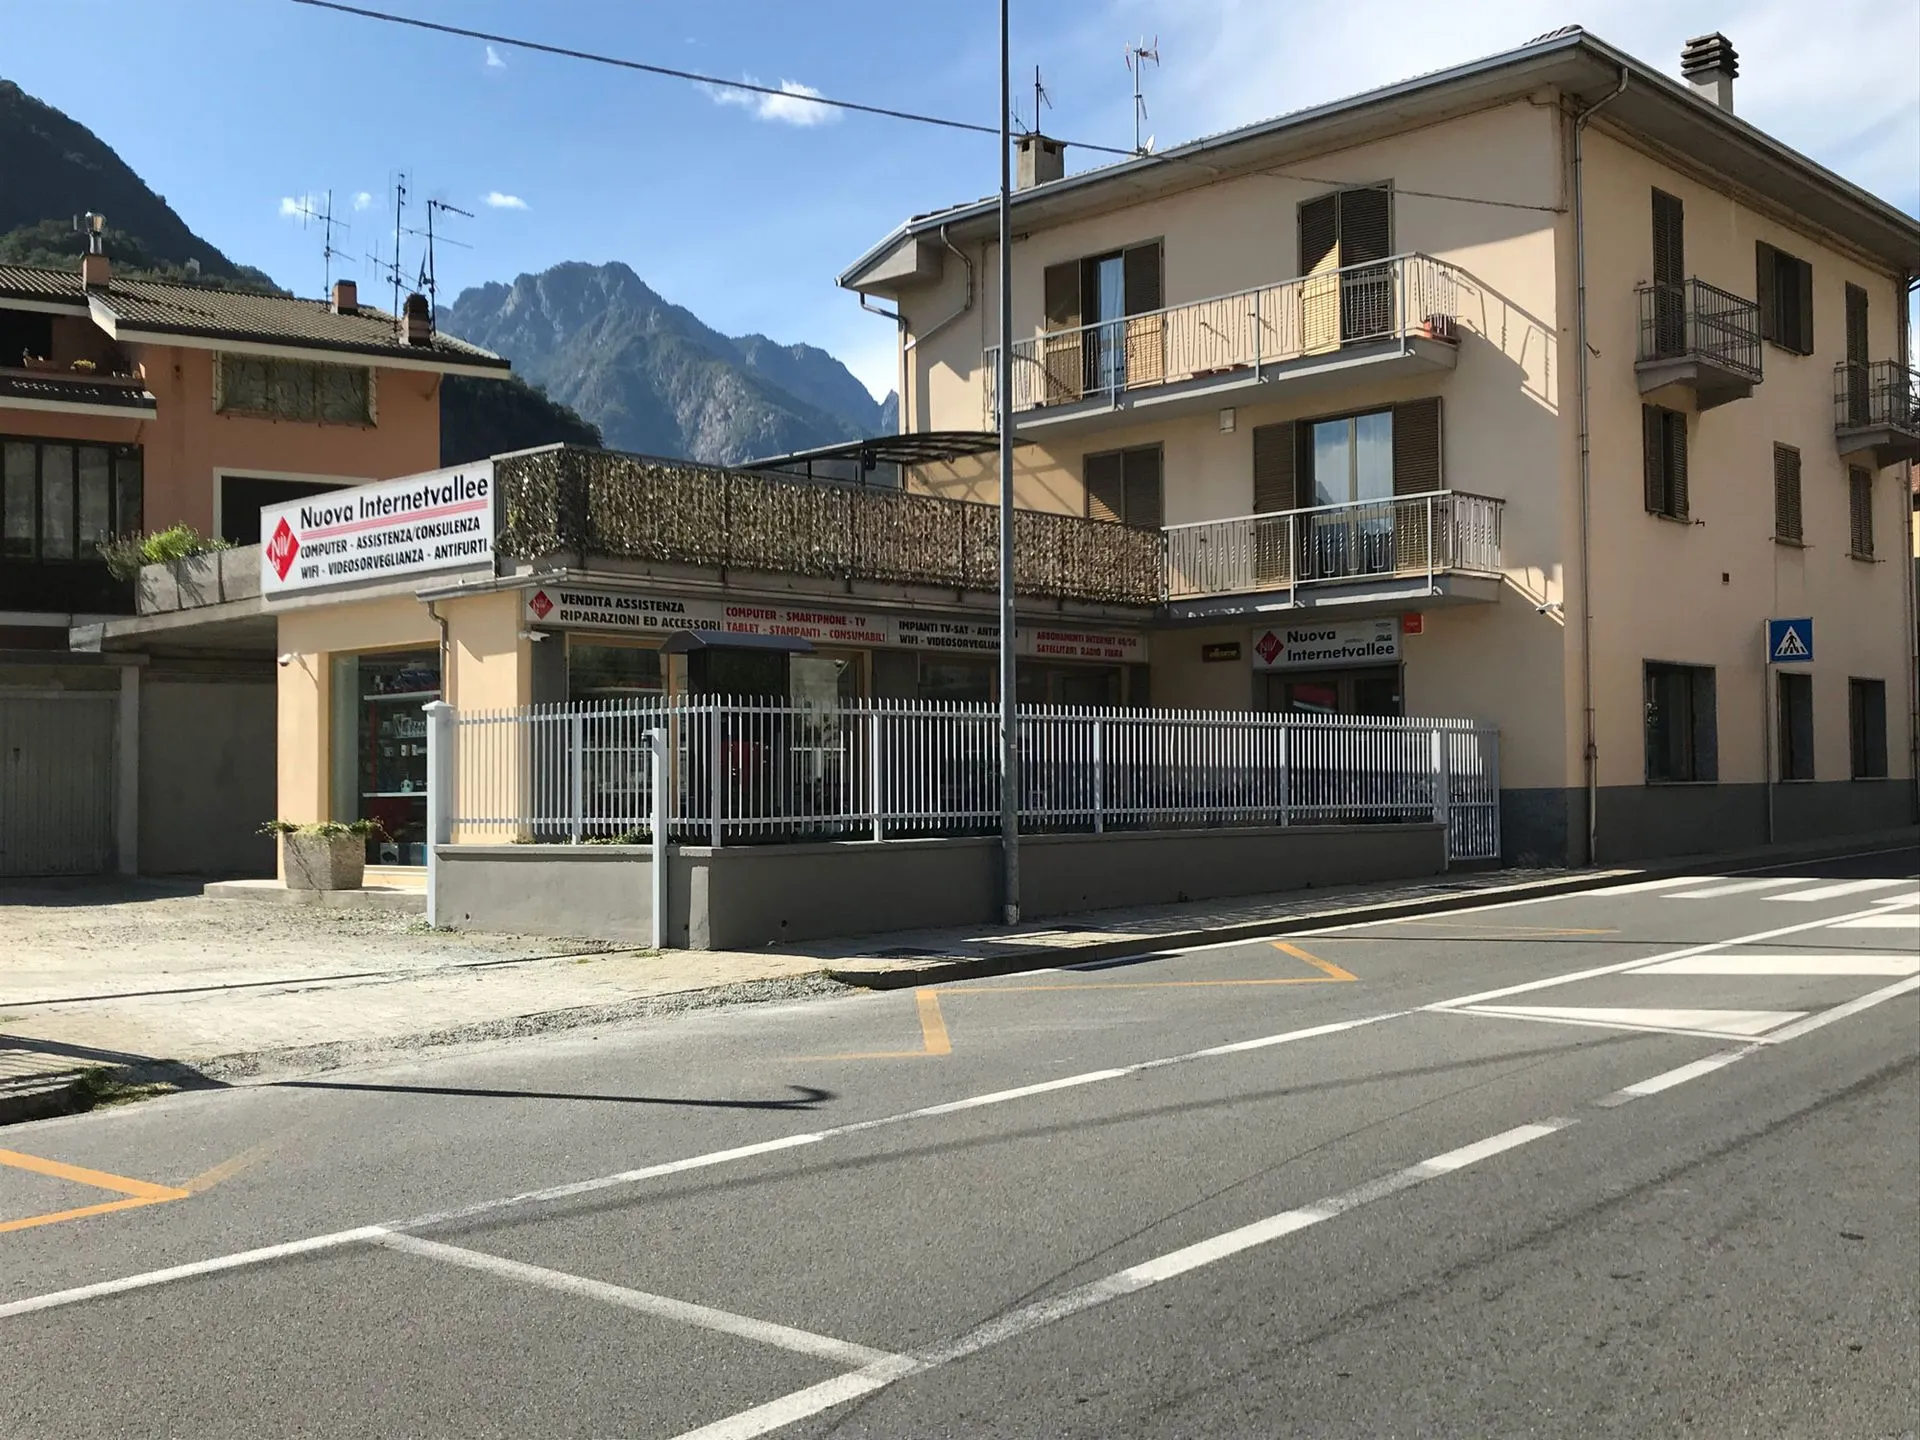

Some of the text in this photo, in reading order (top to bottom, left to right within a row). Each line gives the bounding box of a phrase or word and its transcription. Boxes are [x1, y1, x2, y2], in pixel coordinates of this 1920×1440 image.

[301, 474, 488, 530] Nuova Internetvallee
[300, 540, 347, 559] COMPUTER
[356, 516, 481, 550] ASSISTENZA/CONSULENZA
[300, 565, 320, 580] WIFI
[328, 548, 424, 576] VIDEOSORVEGLIANZA
[434, 538, 488, 560] ANTIFURTI
[560, 593, 685, 613] VENDITA ASSISTENZA
[560, 609, 721, 631] RIPARAZIONI ED ACCESSORI
[726, 607, 777, 620] COMPUTER
[786, 611, 847, 626] SMARTPHONE
[855, 617, 866, 627] TV
[726, 622, 759, 634] TABLET
[769, 625, 821, 639] STAMPANTI
[829, 629, 886, 643] CONSUMABILI
[898, 620, 938, 633] IMPIANTI
[940, 623, 969, 636] TV-SAT
[1287, 629, 1336, 643] Nuova
[899, 635, 918, 645] WIFI
[1287, 642, 1395, 662] Internetvallee
